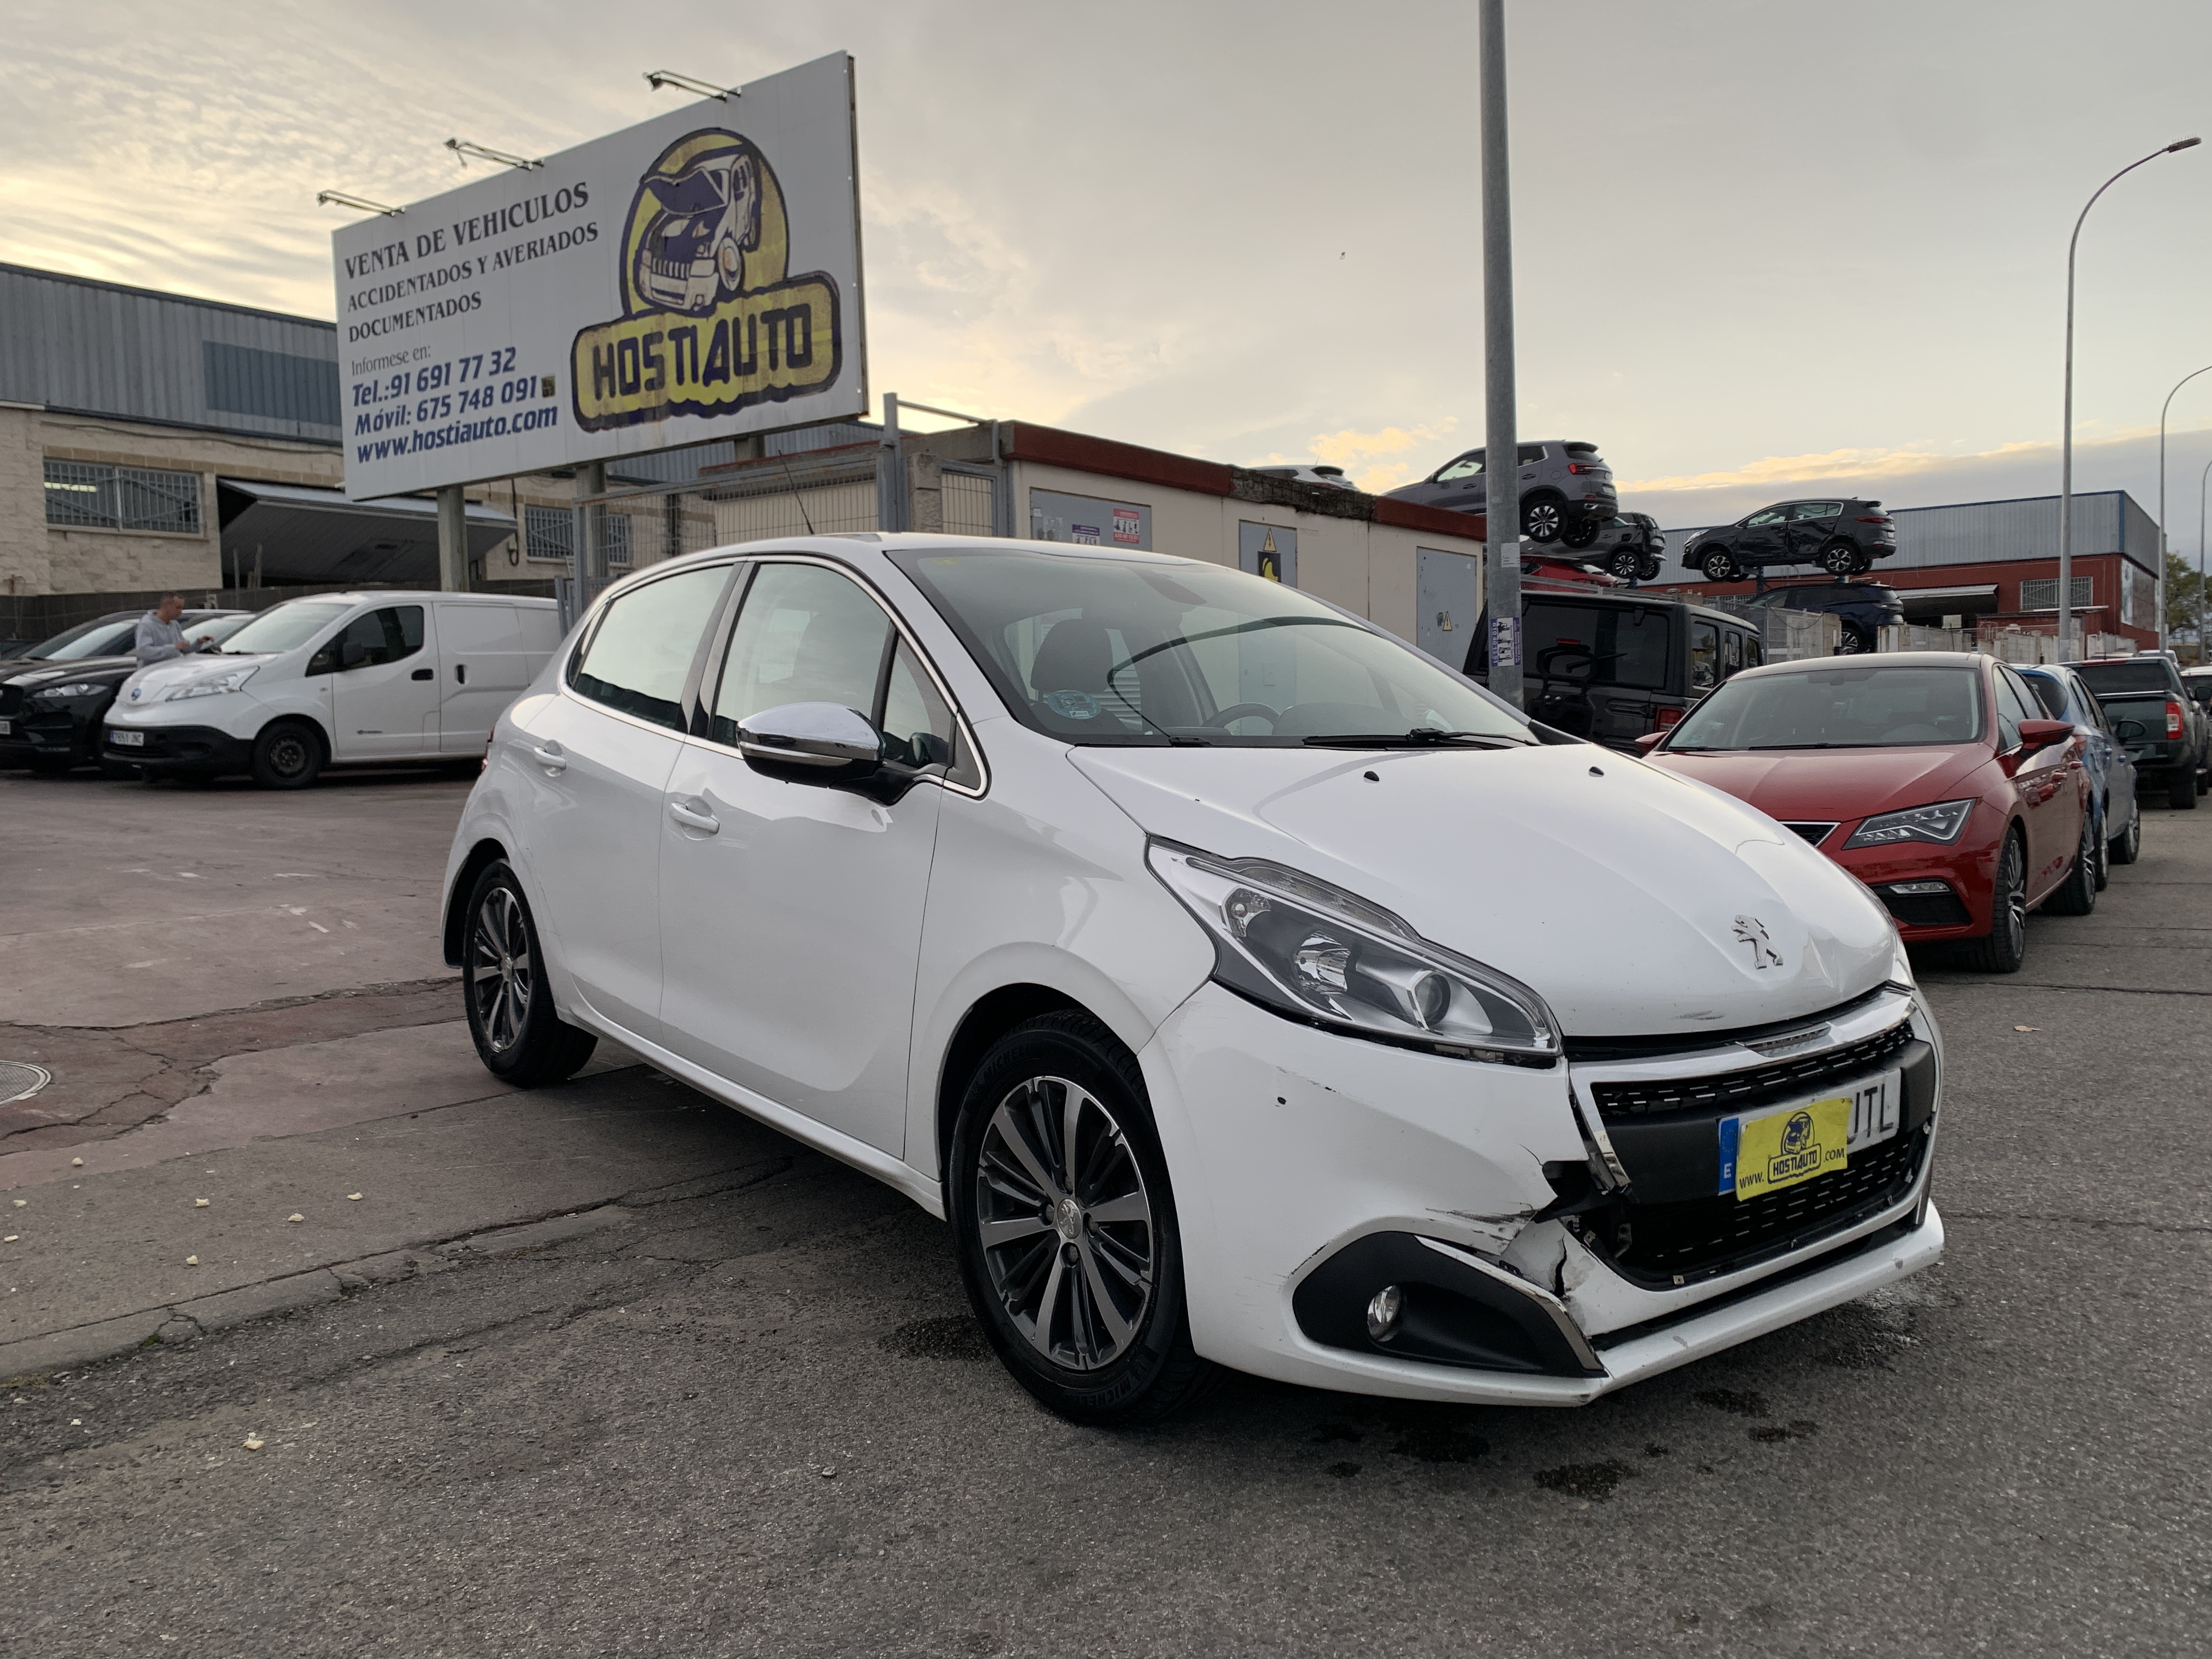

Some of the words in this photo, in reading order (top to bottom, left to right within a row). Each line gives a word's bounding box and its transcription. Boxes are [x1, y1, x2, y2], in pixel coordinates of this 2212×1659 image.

[345, 240, 409, 279] VENTA
[416, 228, 446, 259] DE
[453, 182, 589, 246] VEHICULOS
[347, 261, 472, 313] ACCIDENTADOS
[477, 255, 489, 275] Y
[492, 222, 599, 272] AVERIADOS
[349, 291, 482, 341] DOCUMENTADOS
[352, 353, 409, 376] Informese
[413, 345, 431, 362] en:
[416, 362, 452, 393] 691
[459, 354, 483, 383] 77
[489, 346, 516, 376] 32
[592, 303, 812, 402] HOSTIAUTO
[354, 405, 411, 436] Móvil:
[416, 394, 451, 422] 675
[458, 385, 494, 414] 748
[501, 375, 538, 404] 091
[357, 406, 558, 464] www.hostiauto.com
[1723, 1163, 1733, 1179] E
[1773, 1150, 1818, 1176] HOSTIAUTO
